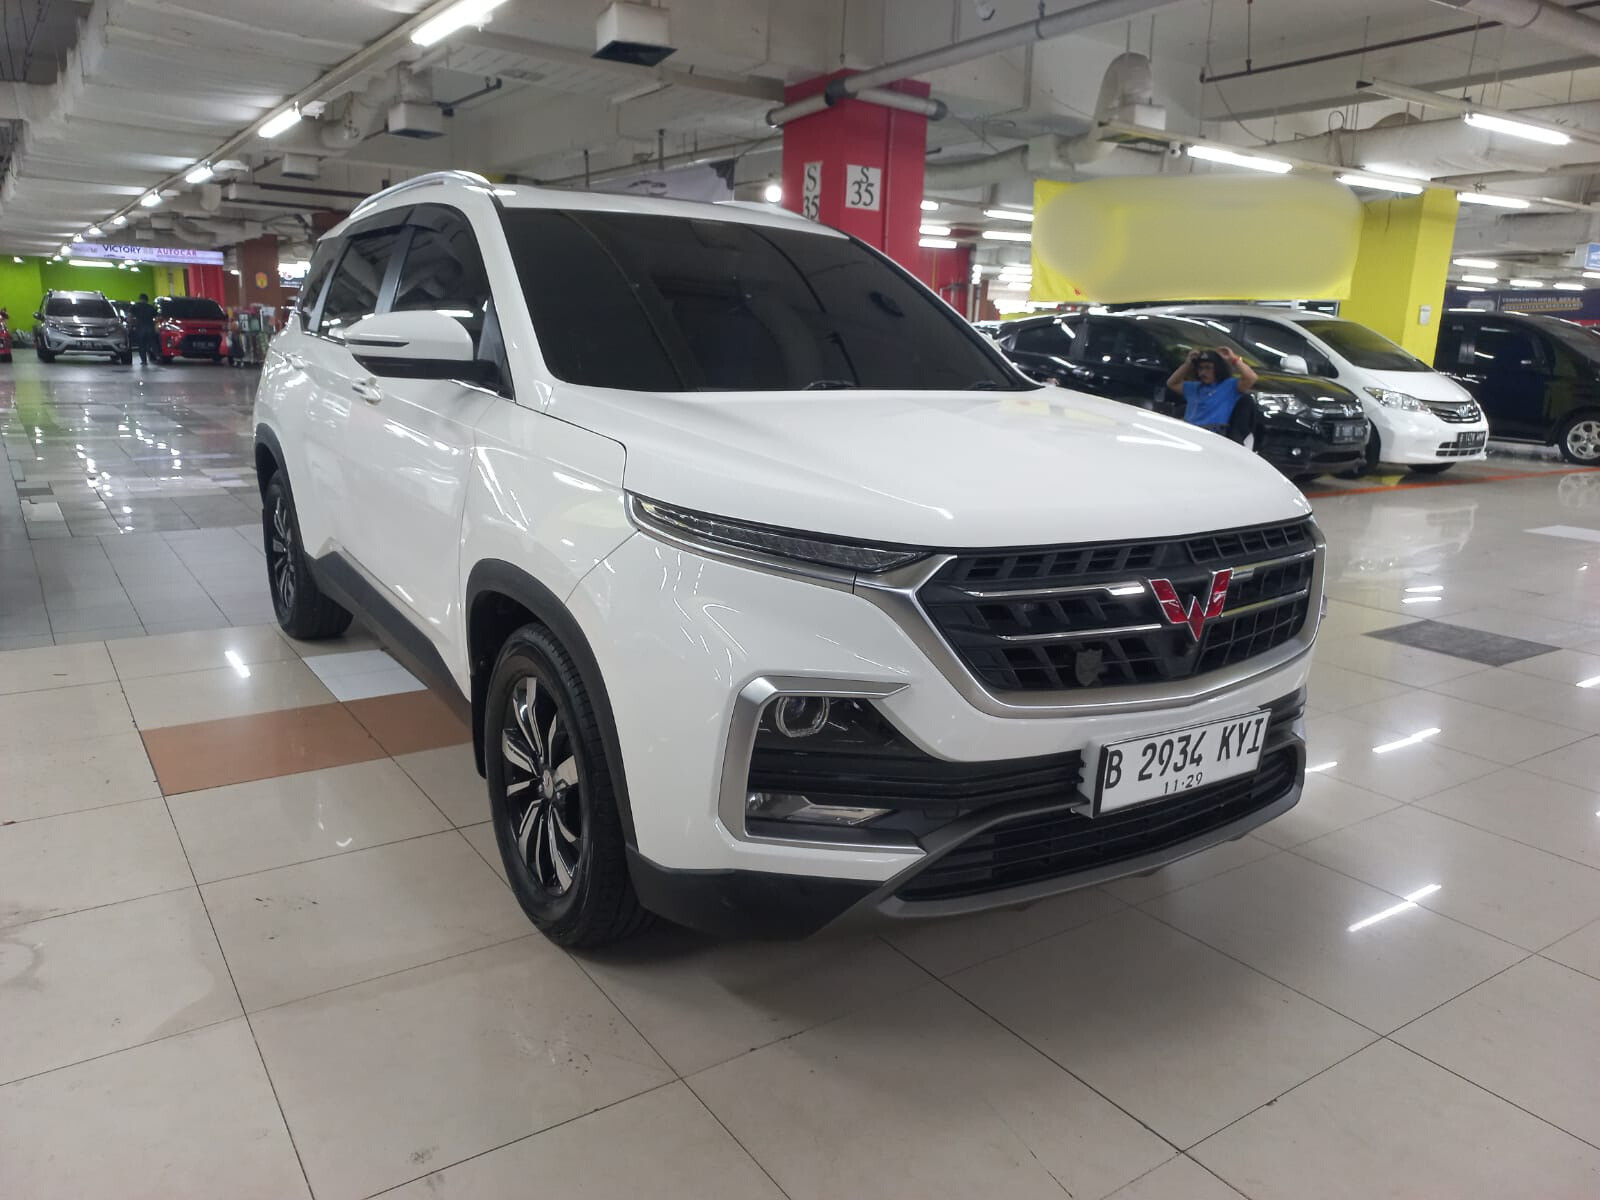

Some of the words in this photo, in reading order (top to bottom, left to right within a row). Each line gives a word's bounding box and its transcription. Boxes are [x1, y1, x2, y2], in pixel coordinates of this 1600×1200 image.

[806, 165, 817, 192] S
[860, 167, 870, 184] S
[850, 181, 875, 206] 35
[804, 195, 819, 219] 35
[102, 243, 141, 254] VICTORY
[156, 247, 198, 257] AUTOCAR
[1105, 749, 1124, 790] B
[1137, 730, 1208, 782] 2934
[1216, 717, 1265, 762] KYI
